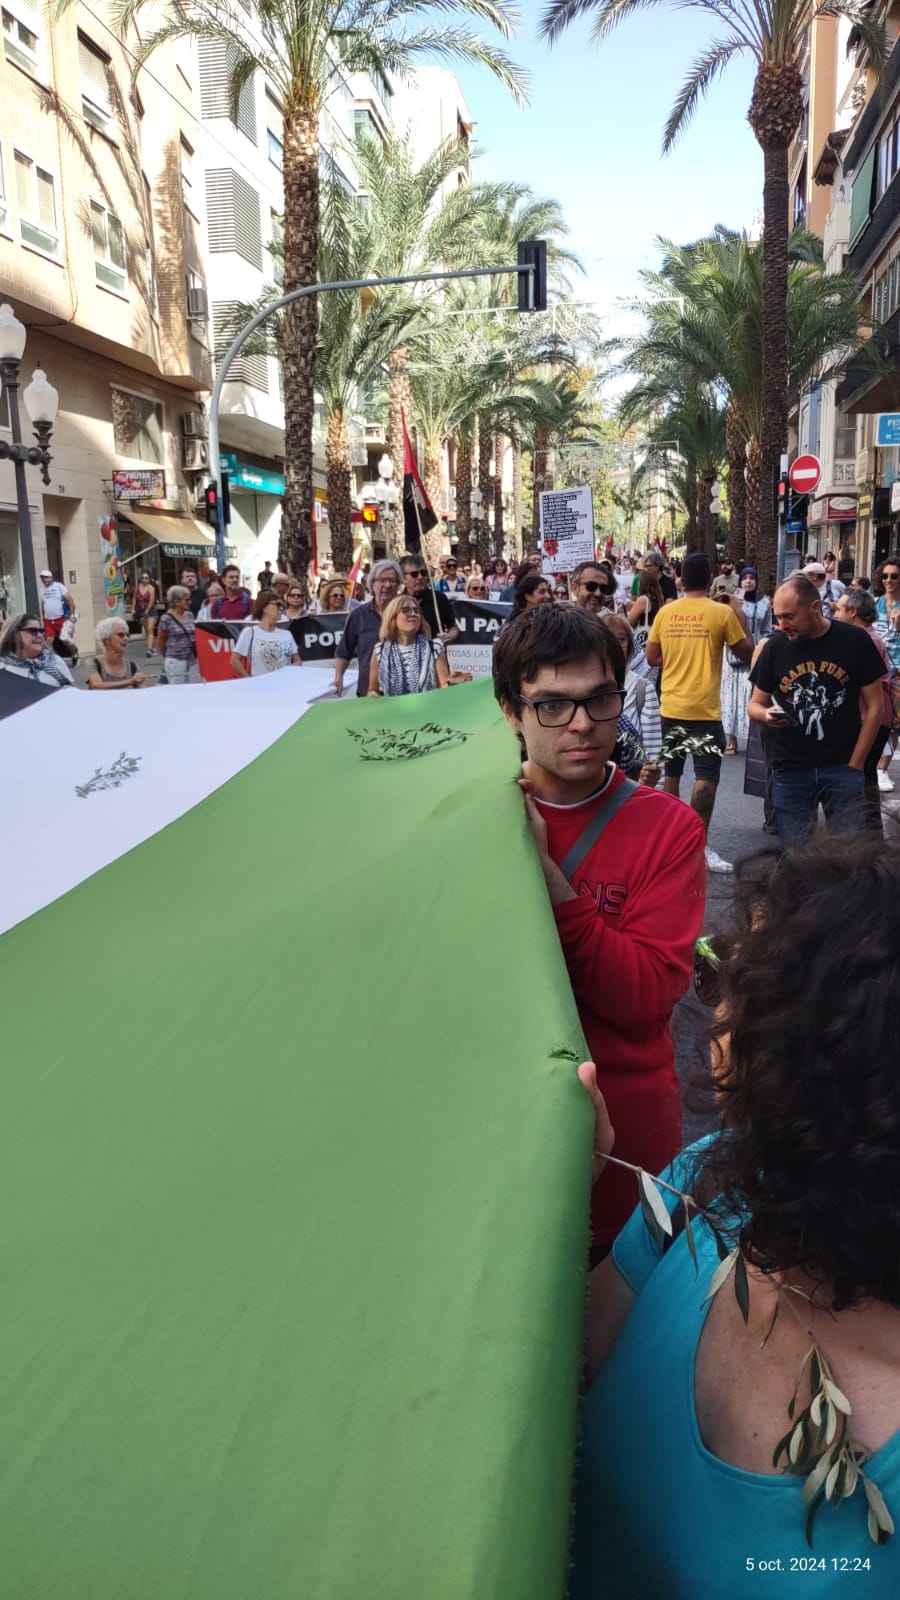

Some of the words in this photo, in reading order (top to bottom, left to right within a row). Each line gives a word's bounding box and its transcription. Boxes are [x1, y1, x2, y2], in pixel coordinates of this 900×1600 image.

[473, 617, 506, 632] PA
[474, 649, 490, 658] LAS
[779, 660, 816, 693] GRAND
[570, 879, 629, 915] NS
